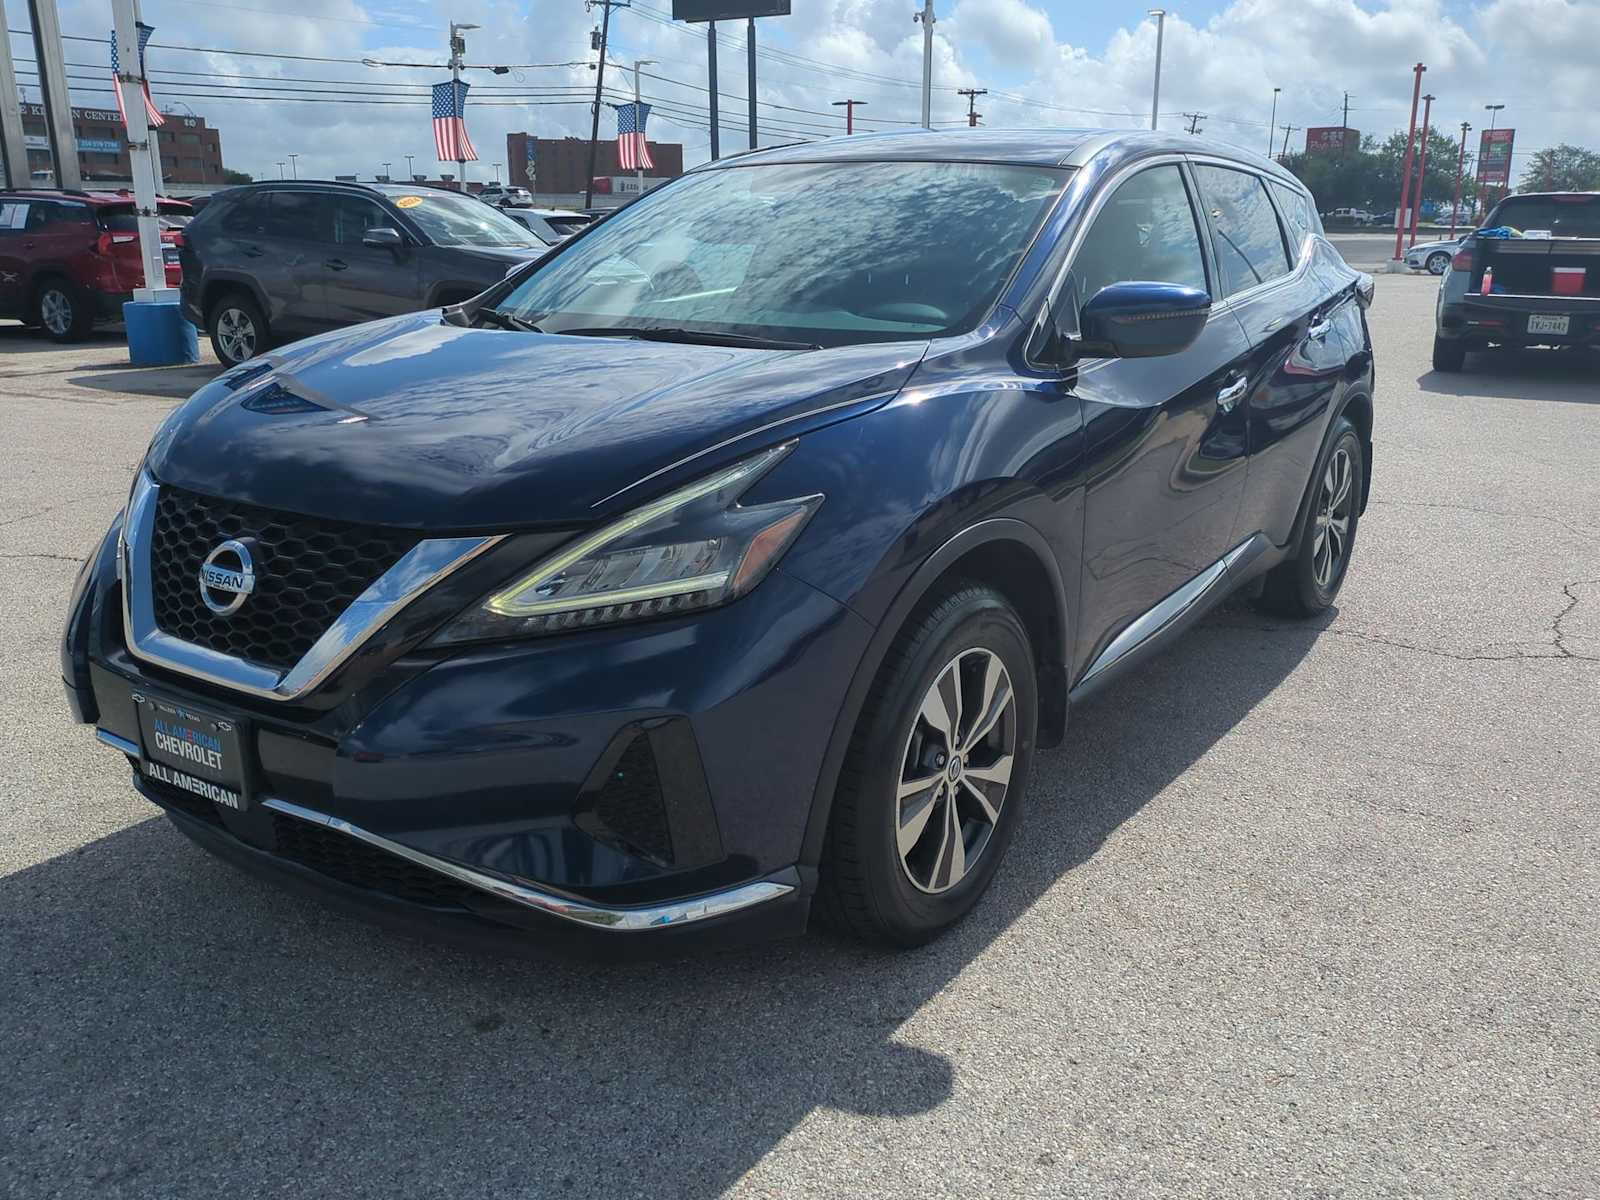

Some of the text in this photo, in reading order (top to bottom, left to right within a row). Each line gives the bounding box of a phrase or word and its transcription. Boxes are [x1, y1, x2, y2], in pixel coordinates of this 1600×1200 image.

[84, 110, 121, 122] CENTE
[202, 566, 243, 588] NISSAN
[154, 719, 222, 753] ALL AMERICAN
[154, 731, 223, 771] CHEVROLET
[149, 762, 239, 809] ALL AMERICAN
